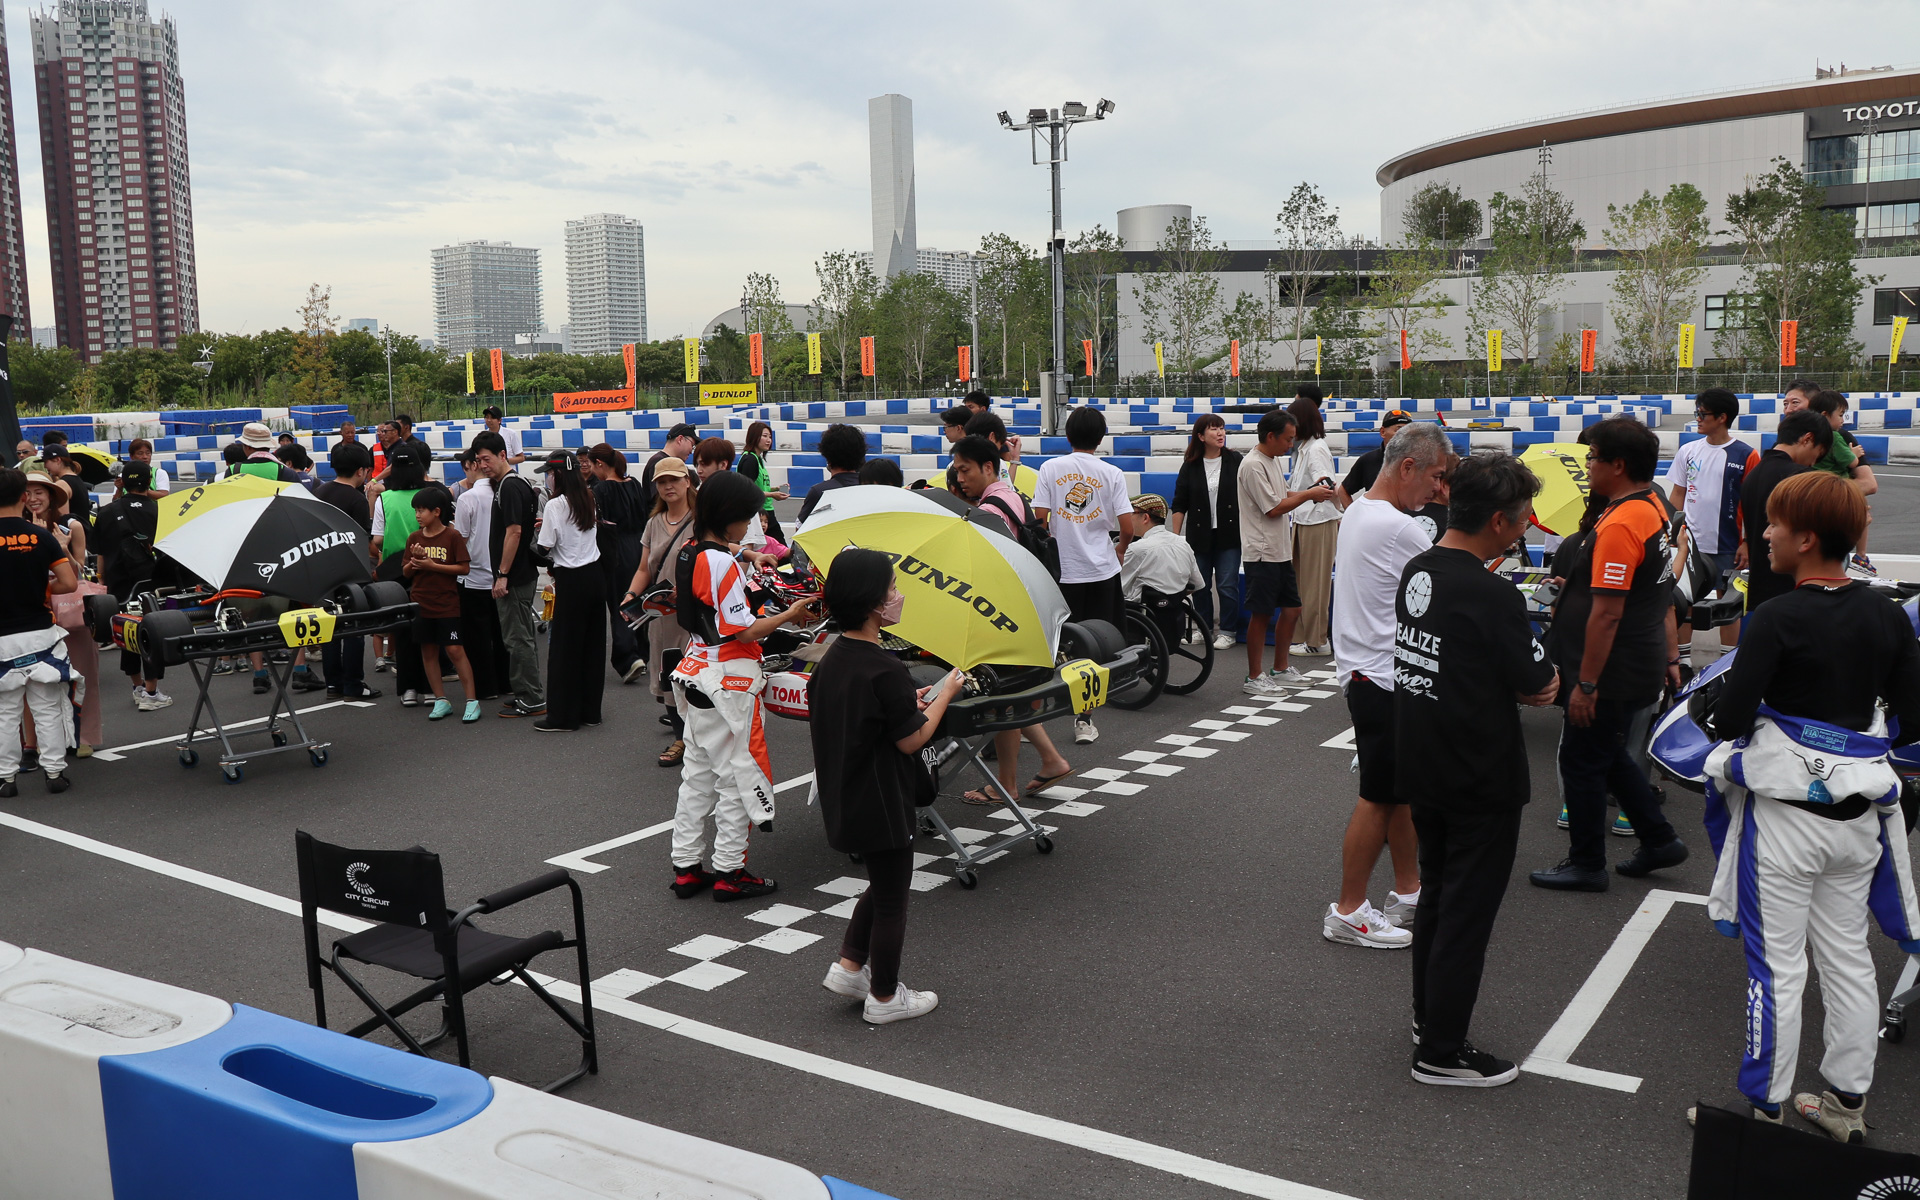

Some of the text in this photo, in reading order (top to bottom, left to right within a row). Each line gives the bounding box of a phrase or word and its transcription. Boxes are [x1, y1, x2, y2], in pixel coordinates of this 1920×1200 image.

[1842, 100, 1920, 122] TOYOT
[572, 395, 628, 406] AUTOBACS
[711, 390, 753, 399] DUNLOP
[1056, 473, 1103, 490] EVERY BOX
[1087, 506, 1103, 521] HOT
[280, 531, 356, 569] DUNLOP
[295, 614, 321, 639] 65
[298, 636, 322, 646] JAF
[1396, 622, 1441, 656] EALIZE
[1080, 667, 1101, 702] 36
[1082, 699, 1101, 712] JAF
[753, 785, 774, 813] TOM'S
[345, 892, 390, 906] CITY CIRCUIT
